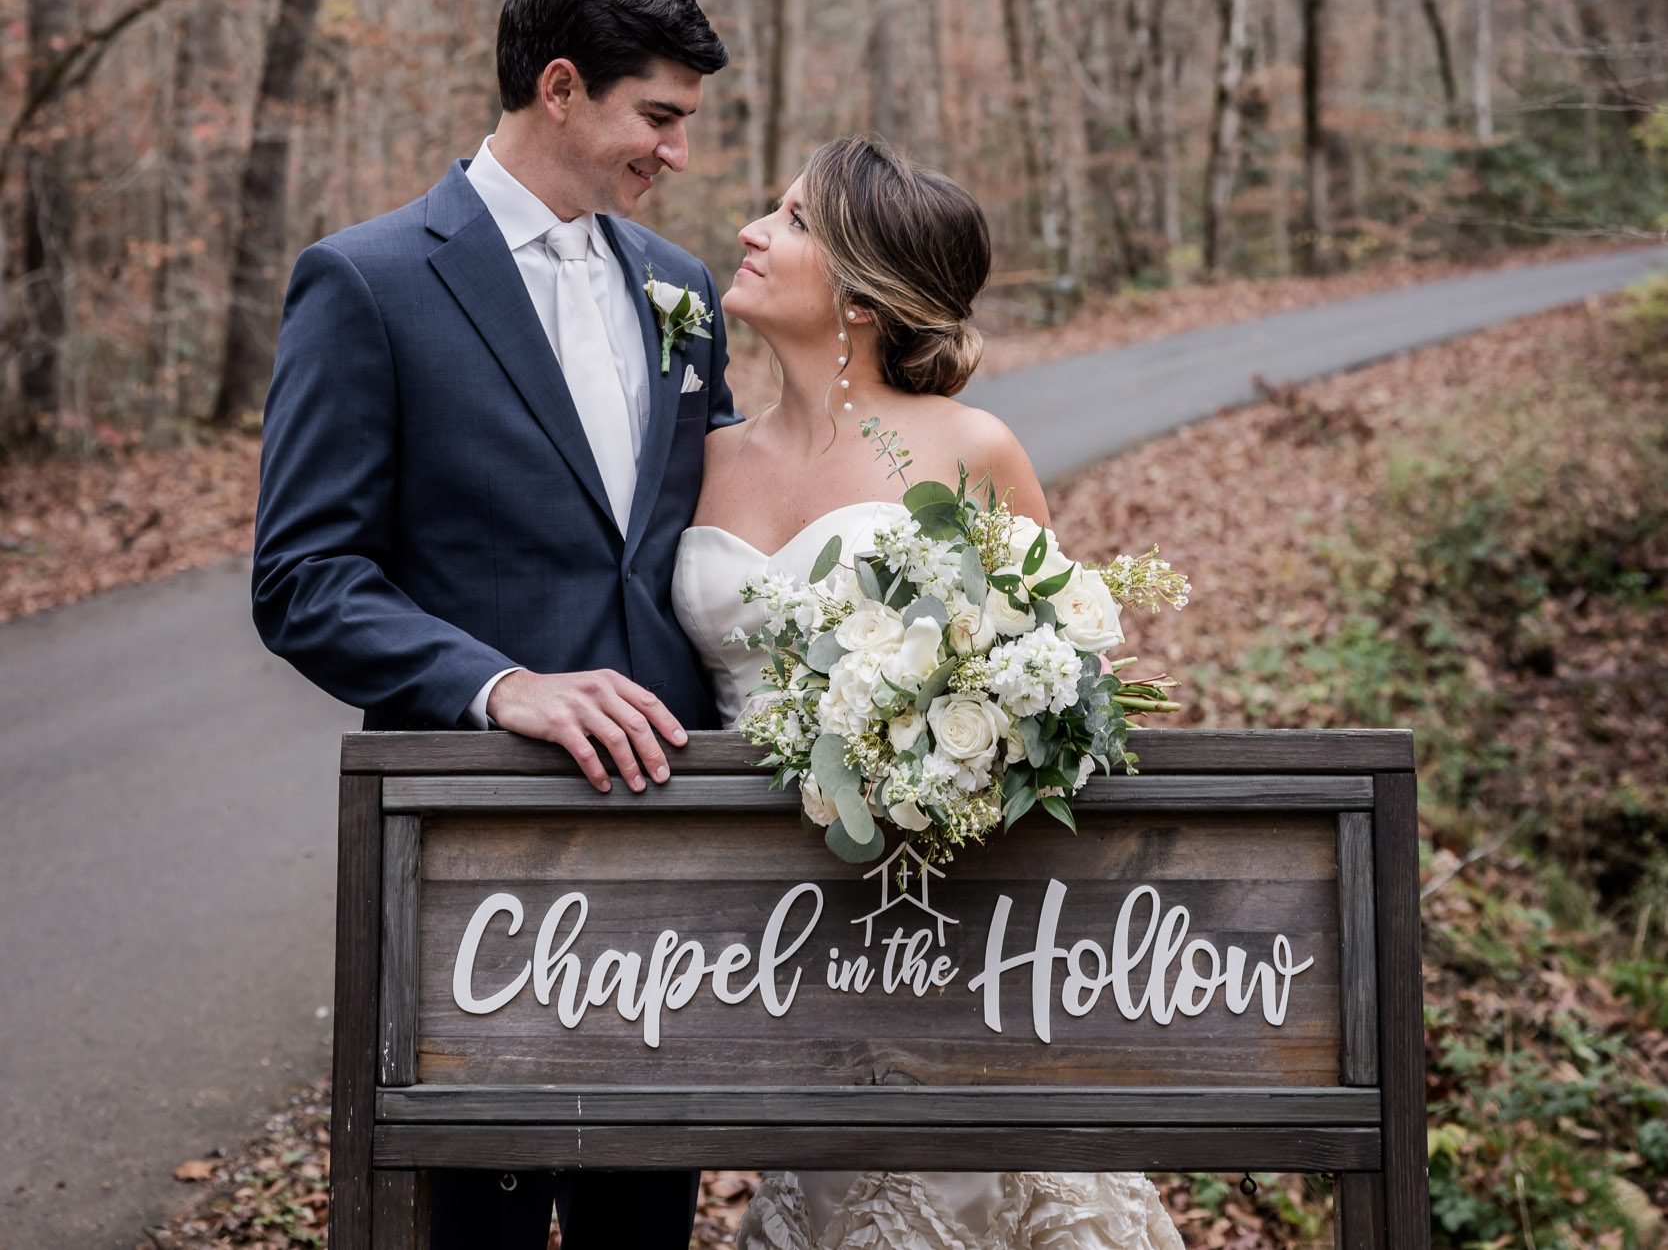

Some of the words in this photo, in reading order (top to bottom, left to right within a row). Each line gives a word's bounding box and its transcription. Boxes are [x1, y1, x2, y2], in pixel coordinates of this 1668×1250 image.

[452, 881, 824, 1048] Chapel
[826, 947, 876, 994] in
[881, 926, 960, 997] the
[967, 878, 1314, 1044] Hollow
